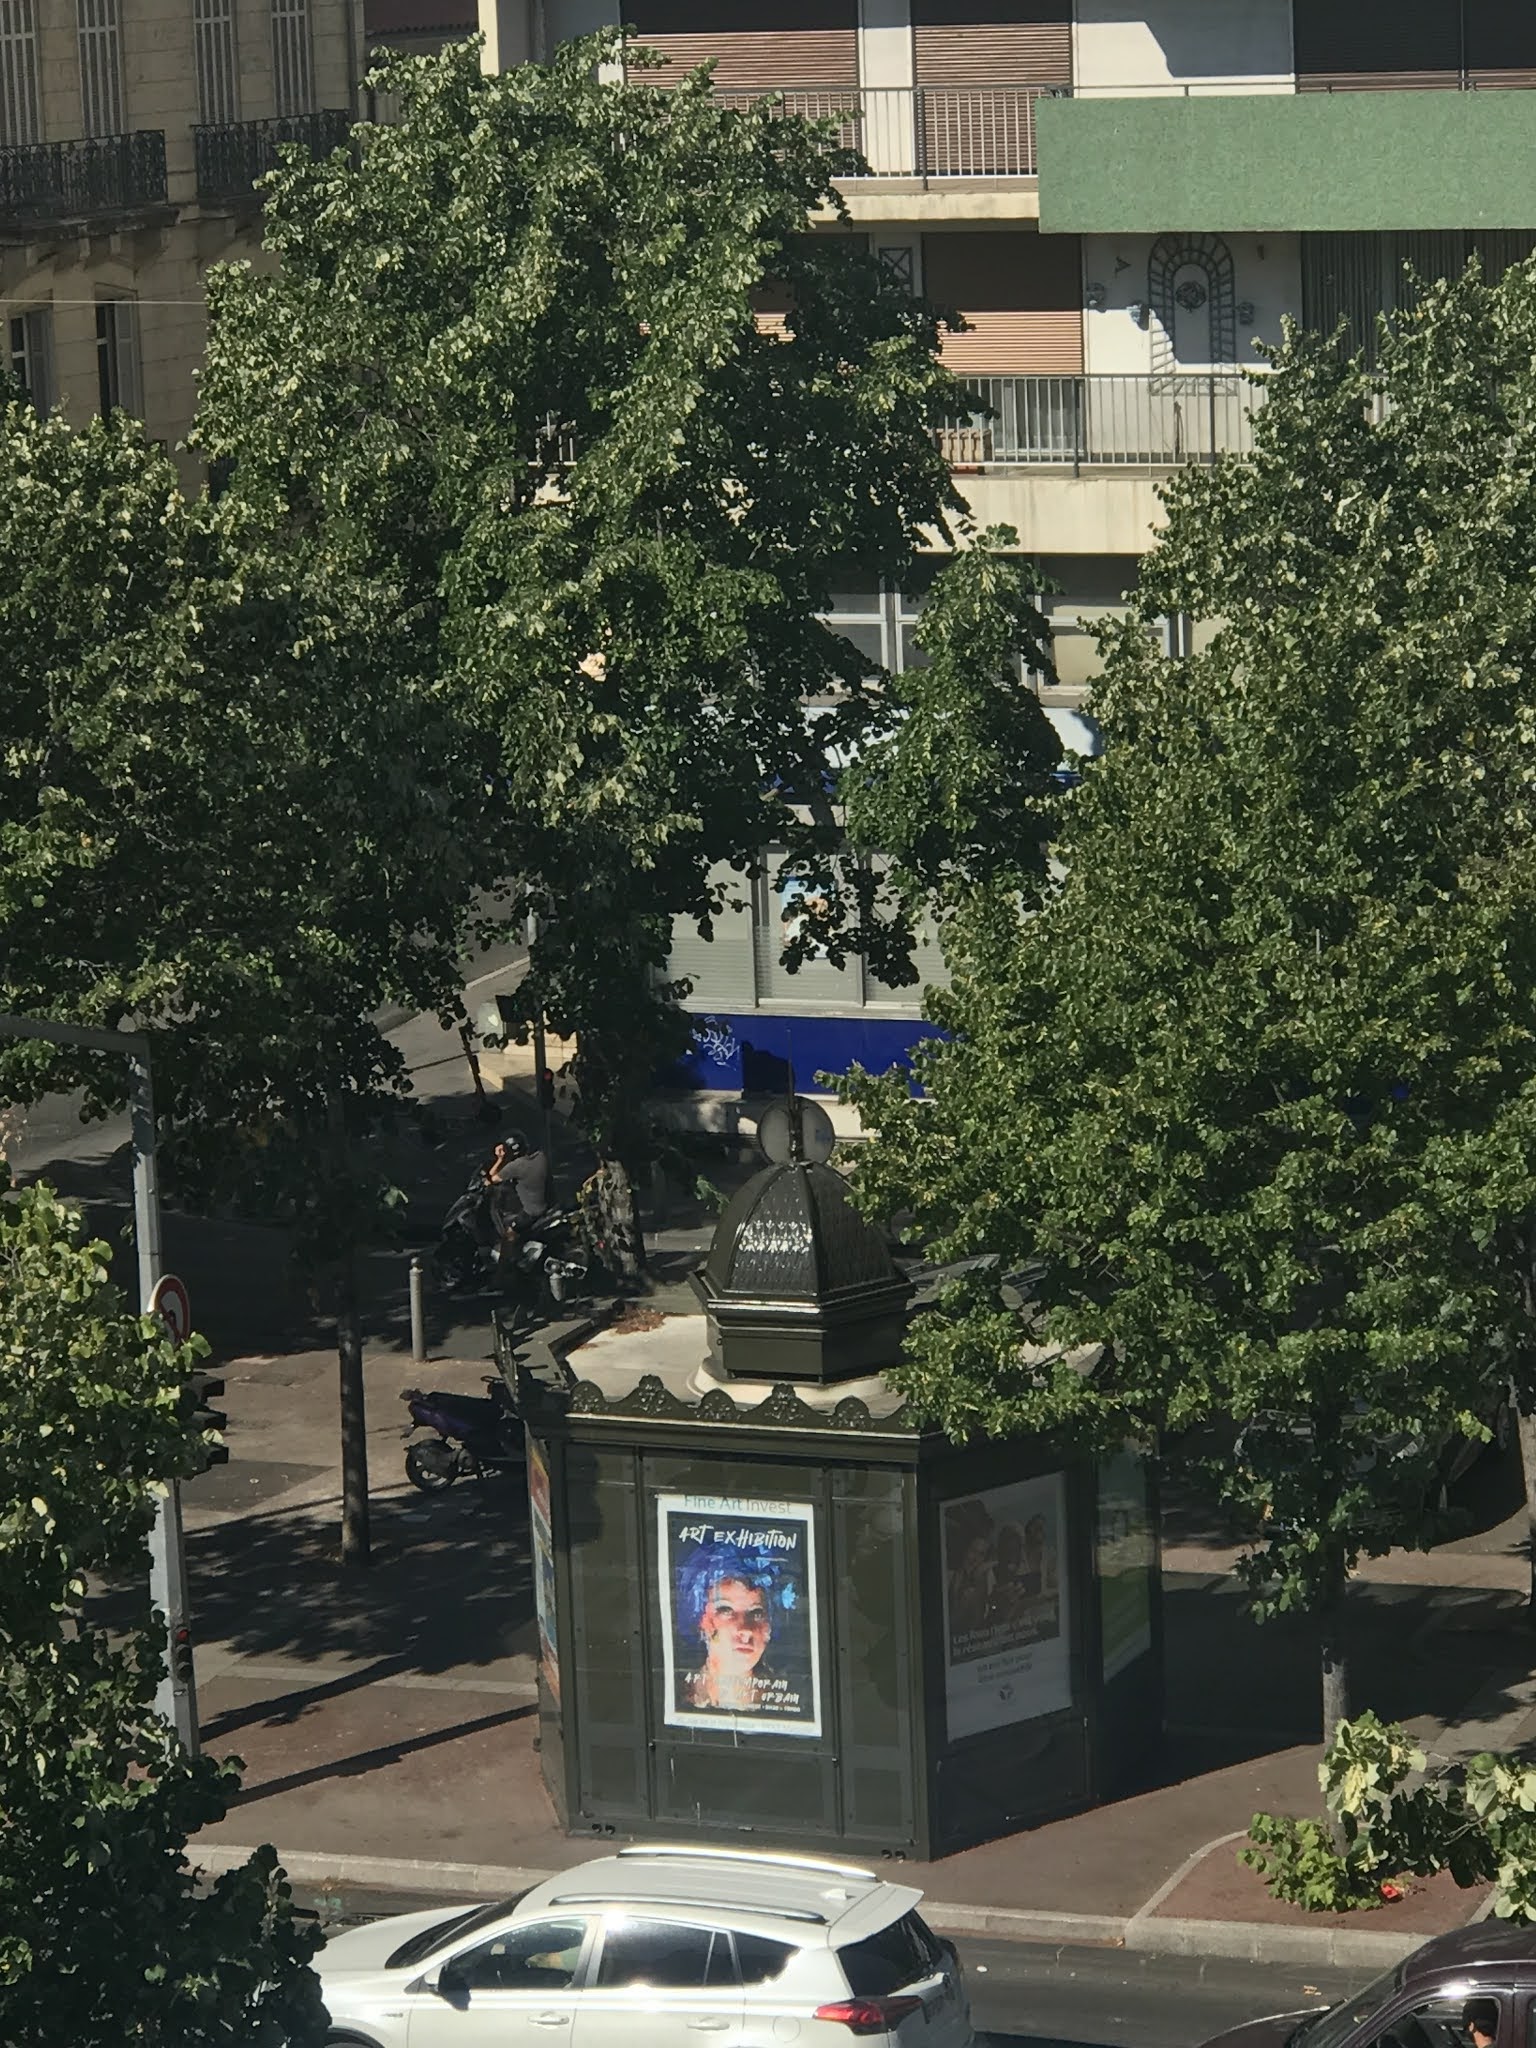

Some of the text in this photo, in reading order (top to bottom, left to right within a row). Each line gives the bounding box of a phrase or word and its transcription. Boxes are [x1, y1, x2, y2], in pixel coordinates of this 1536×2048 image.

[684, 1495, 792, 1515] Fine Art Invest
[678, 1523, 797, 1551] ART EXHIBITION
